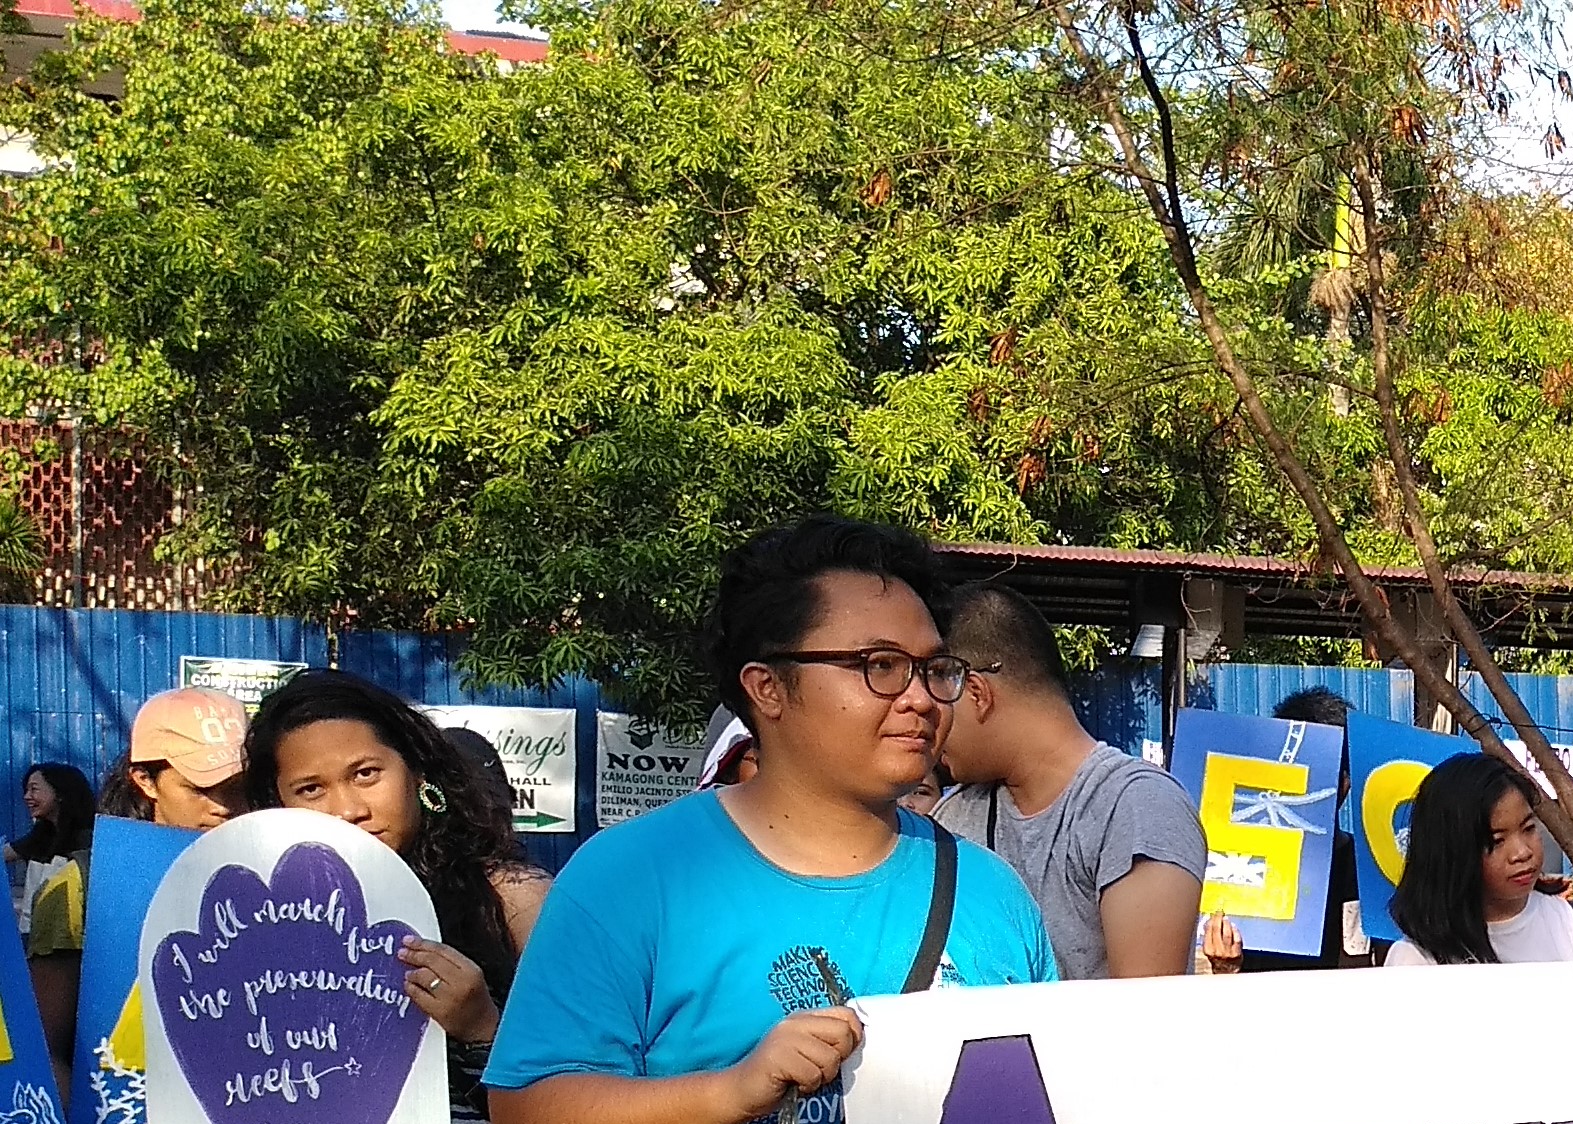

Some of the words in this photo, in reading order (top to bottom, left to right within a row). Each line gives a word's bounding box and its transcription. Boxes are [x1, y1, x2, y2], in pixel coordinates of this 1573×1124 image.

[606, 752, 691, 774] NOW
[509, 777, 552, 786] HALL
[601, 771, 664, 786] KAMAGONG
[601, 784, 633, 795] EMILIO
[634, 787, 674, 797] JACINTO
[601, 796, 642, 808] DILIMAN,
[601, 807, 625, 817] NEAR
[1199, 751, 1310, 921] S
[170, 942, 193, 984] I
[198, 898, 248, 964] will
[253, 888, 347, 935] march
[343, 926, 395, 964] for
[178, 988, 232, 1020] the
[243, 968, 412, 1019] preservation
[246, 1016, 275, 1055] of
[285, 1021, 339, 1052] our
[225, 1058, 321, 1108] reefs
